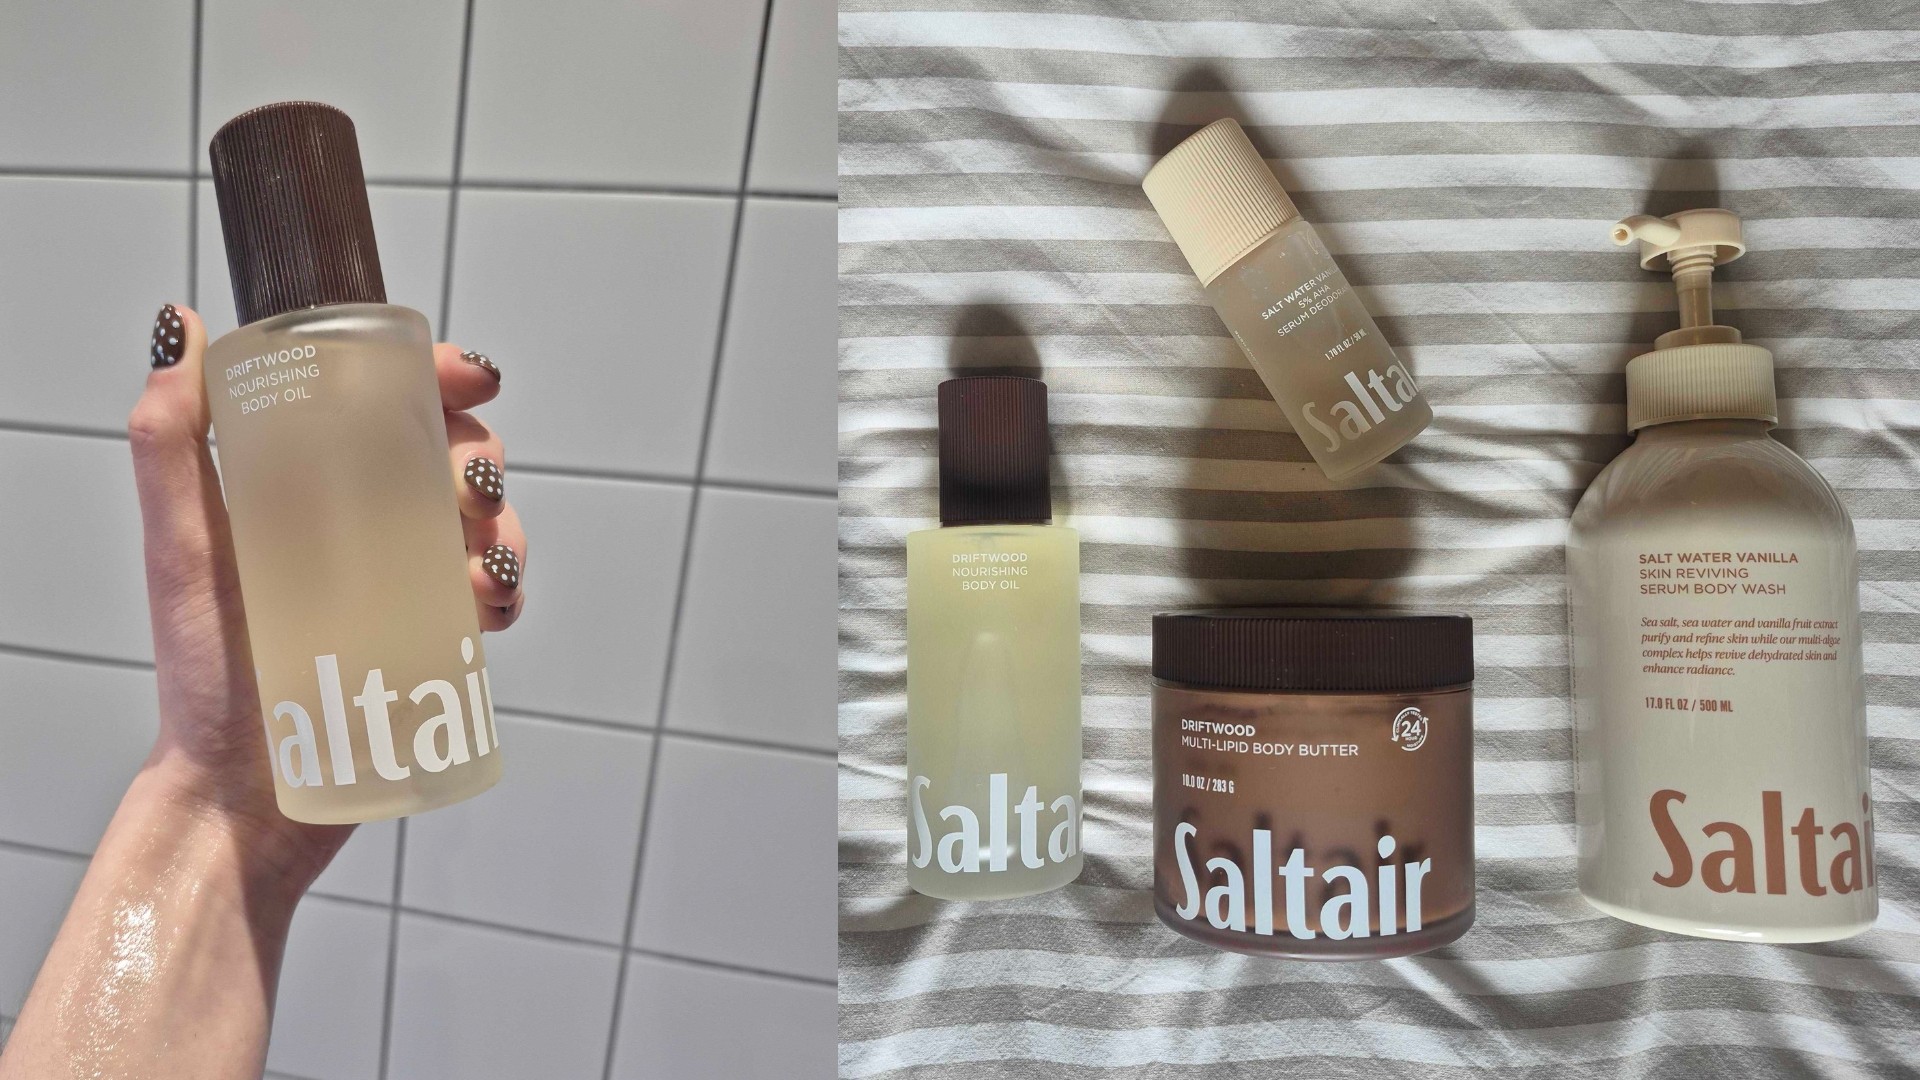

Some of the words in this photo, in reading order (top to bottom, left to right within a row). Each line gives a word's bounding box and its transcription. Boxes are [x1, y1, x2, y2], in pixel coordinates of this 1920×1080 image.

[1261, 300, 1284, 320] SALT
[1283, 279, 1317, 304] WATER
[1315, 264, 1339, 282] VANILL
[1298, 296, 1317, 309] 5%
[1313, 284, 1331, 299] AHA
[1277, 311, 1310, 337] SERUM
[1309, 284, 1350, 315] DEODORAN
[225, 345, 316, 381] DRIFTWOOD
[229, 364, 320, 399] NOURISHING
[241, 392, 279, 415] BODY
[284, 386, 311, 402] OIL
[952, 553, 1028, 563] DRIFTWOOD
[1639, 553, 1673, 564] SALT
[1677, 553, 1732, 564] WATER
[1736, 552, 1799, 564] VANILLA
[952, 566, 1028, 577] NOURISHING
[1639, 568, 1671, 579] SKIN
[1676, 568, 1749, 579] REVIVING
[962, 580, 996, 590] BODY
[1000, 580, 1020, 590] OIL
[1640, 583, 1689, 595] SERUM
[1694, 583, 1737, 594] BODY
[1742, 583, 1786, 595] WASH
[1641, 617, 1658, 627] Sea
[1659, 617, 1679, 628] salt,
[1682, 619, 1699, 628] sea
[1701, 618, 1733, 628] water
[1734, 618, 1755, 629] and
[1757, 618, 1791, 629] vanilla
[1791, 618, 1812, 631] fruit
[1813, 620, 1838, 629] extract
[1641, 632, 1671, 645] purify
[1672, 633, 1694, 643] and
[1695, 633, 1725, 645] refine
[1727, 633, 1748, 644] skin
[1751, 634, 1778, 644] while
[1779, 636, 1797, 644] our
[1642, 648, 1683, 660] complex
[1685, 648, 1713, 661] helps
[1714, 649, 1746, 660] revive
[1748, 649, 1804, 663] dehydrated
[1804, 650, 1822, 661] skin
[1822, 650, 1837, 661] and
[1642, 663, 1684, 674] enhance
[1686, 664, 1735, 675] radiance.
[255, 636, 499, 788] altai
[1645, 697, 1663, 709] 17.0
[1665, 698, 1675, 710] FL
[1677, 698, 1689, 711] OZ
[1700, 699, 1717, 712] 500
[1720, 700, 1733, 712] ML
[1181, 718, 1256, 737] DRIFTWOOD
[1401, 720, 1421, 737] 24
[1181, 735, 1249, 753] MULTI-LIPID
[1252, 742, 1295, 756] BODY
[1299, 744, 1359, 756] BUTTER
[1182, 773, 1195, 788] 10.0
[1196, 777, 1205, 790] OZ
[1212, 779, 1227, 793] 283
[1228, 780, 1235, 793] G
[1174, 821, 1431, 940] Saltair
